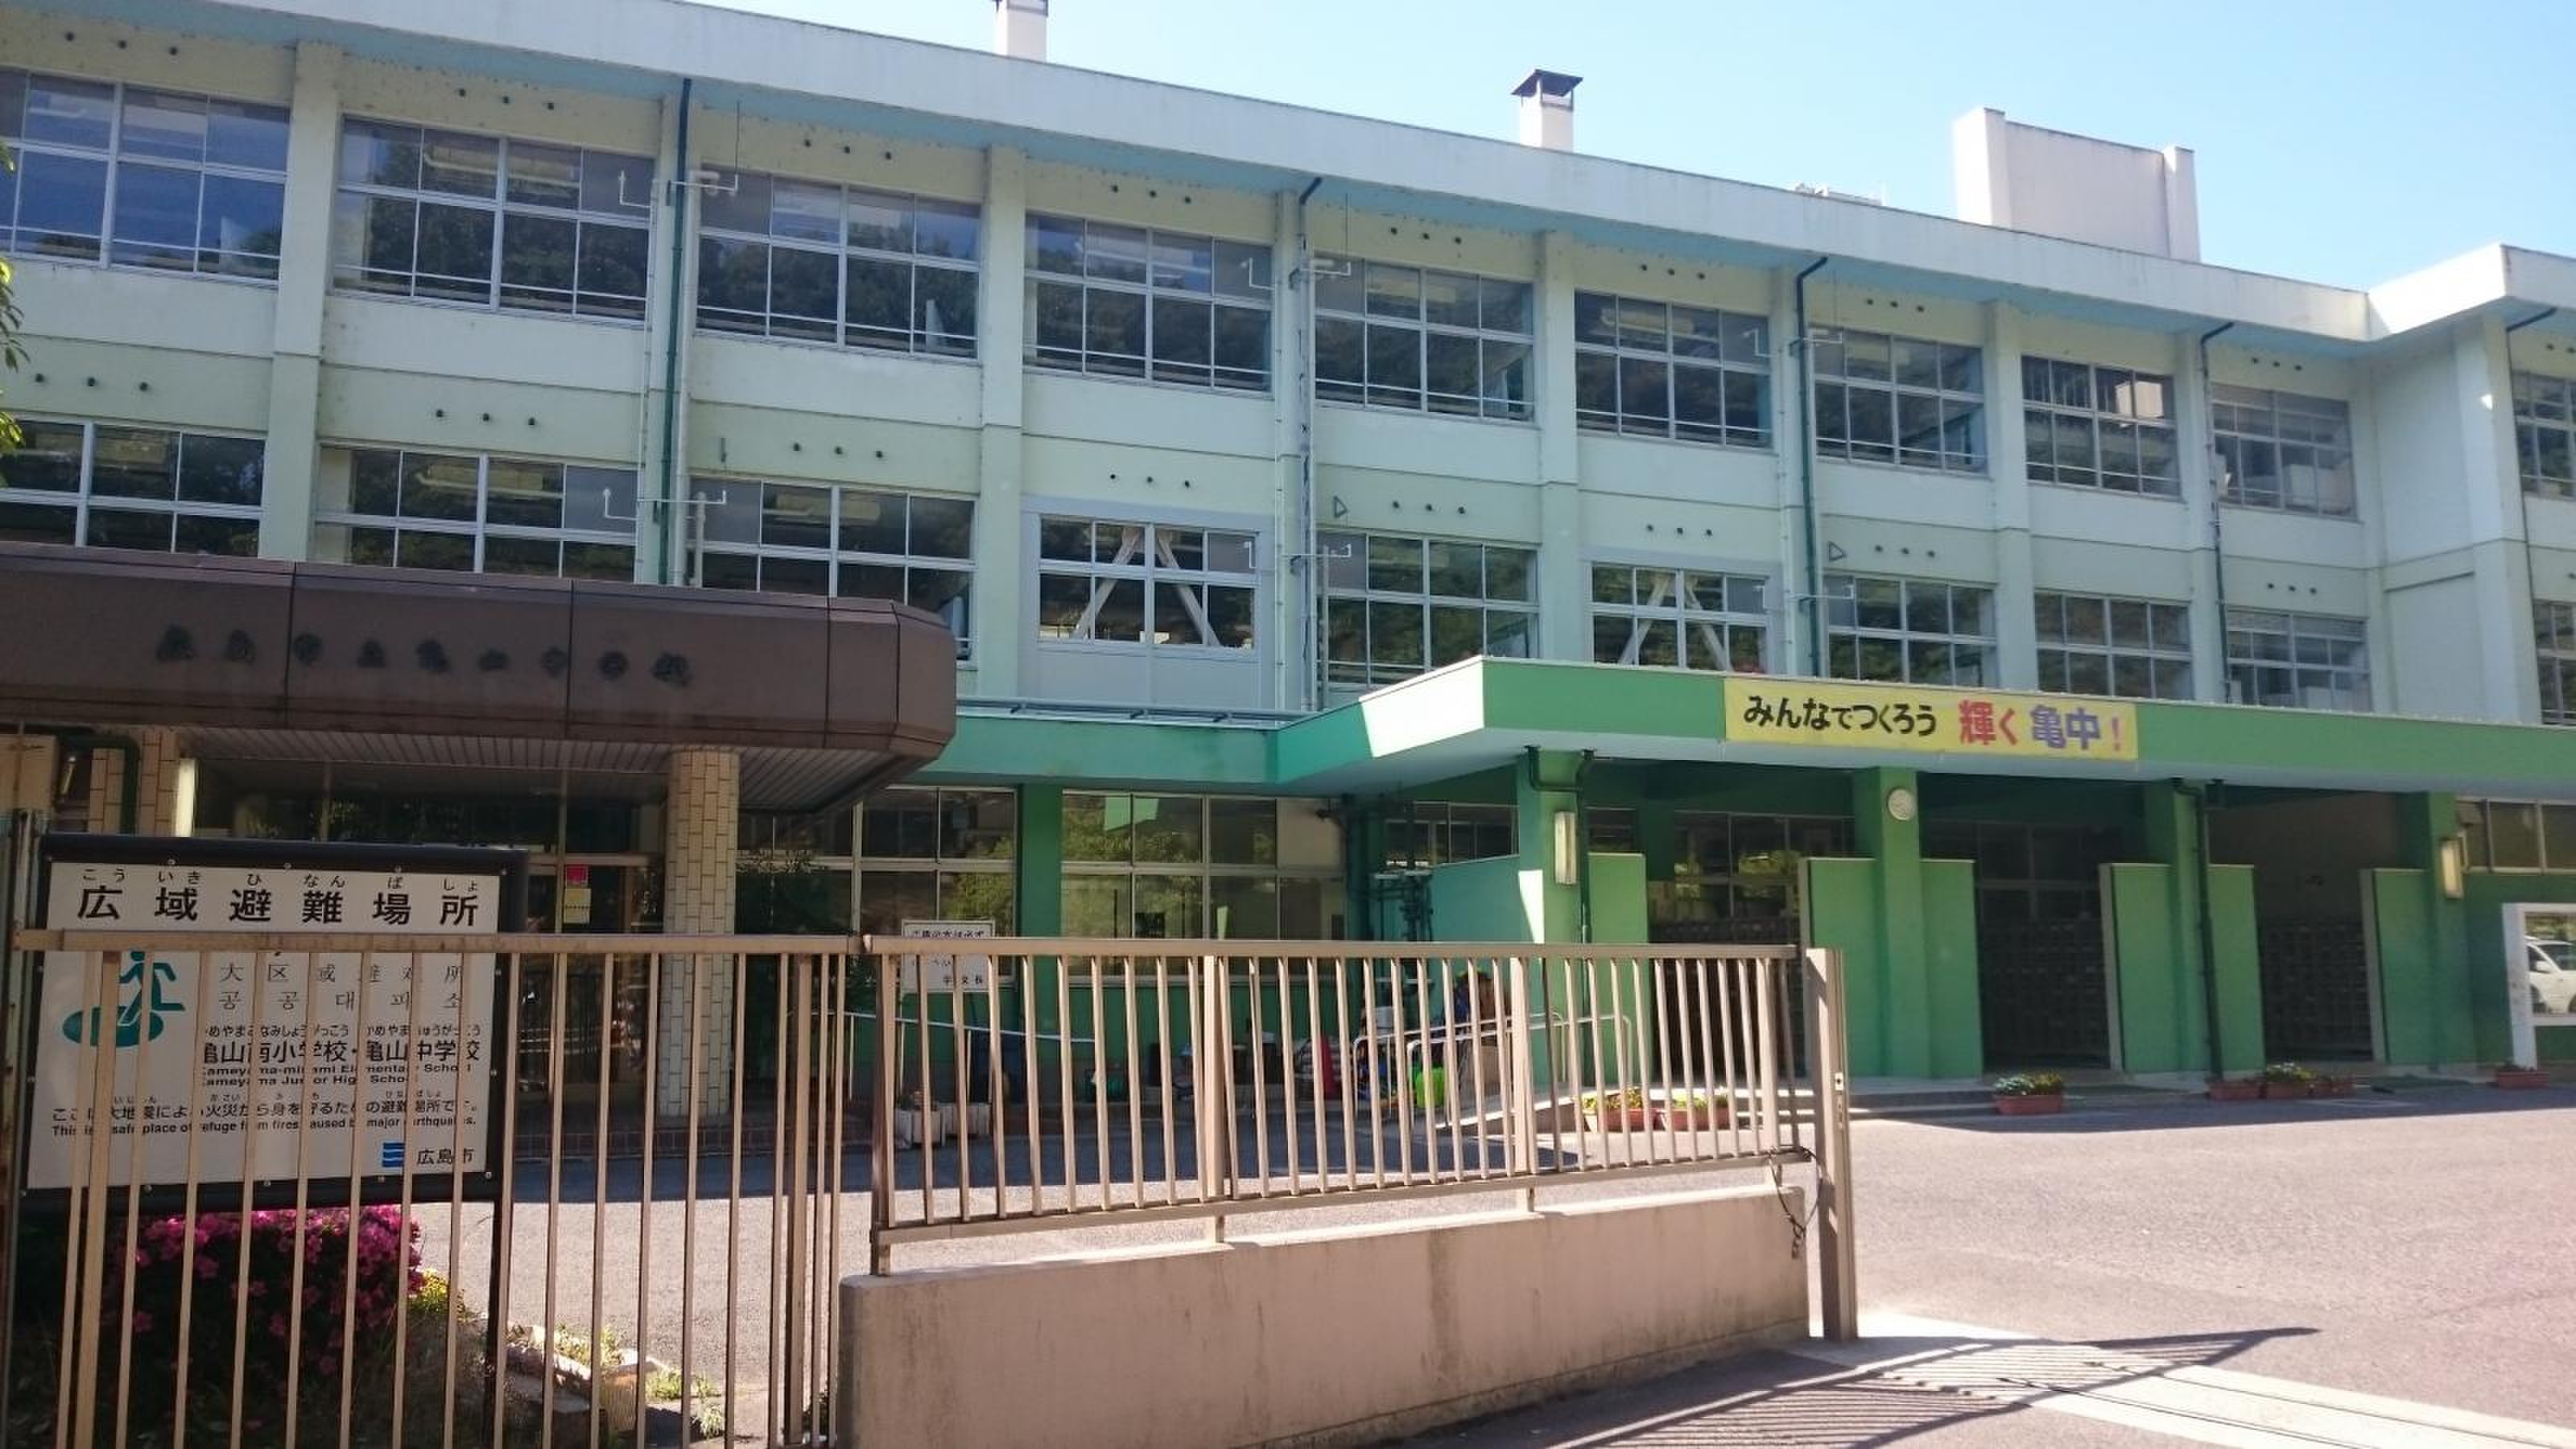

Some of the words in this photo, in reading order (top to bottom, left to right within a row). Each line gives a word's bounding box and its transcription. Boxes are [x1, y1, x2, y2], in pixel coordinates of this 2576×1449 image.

[1743, 695, 1937, 737] みんなでつくろう
[1959, 700, 2017, 745] 輝く
[77, 886, 478, 927] 広域避難場所
[424, 1063, 472, 1072] Schol
[332, 1075, 365, 1086] Hig
[112, 1123, 135, 1133] saf
[142, 1123, 177, 1137] place
[199, 1121, 236, 1133] efuge
[308, 1118, 345, 1129] aused
[366, 1117, 400, 1129] major
